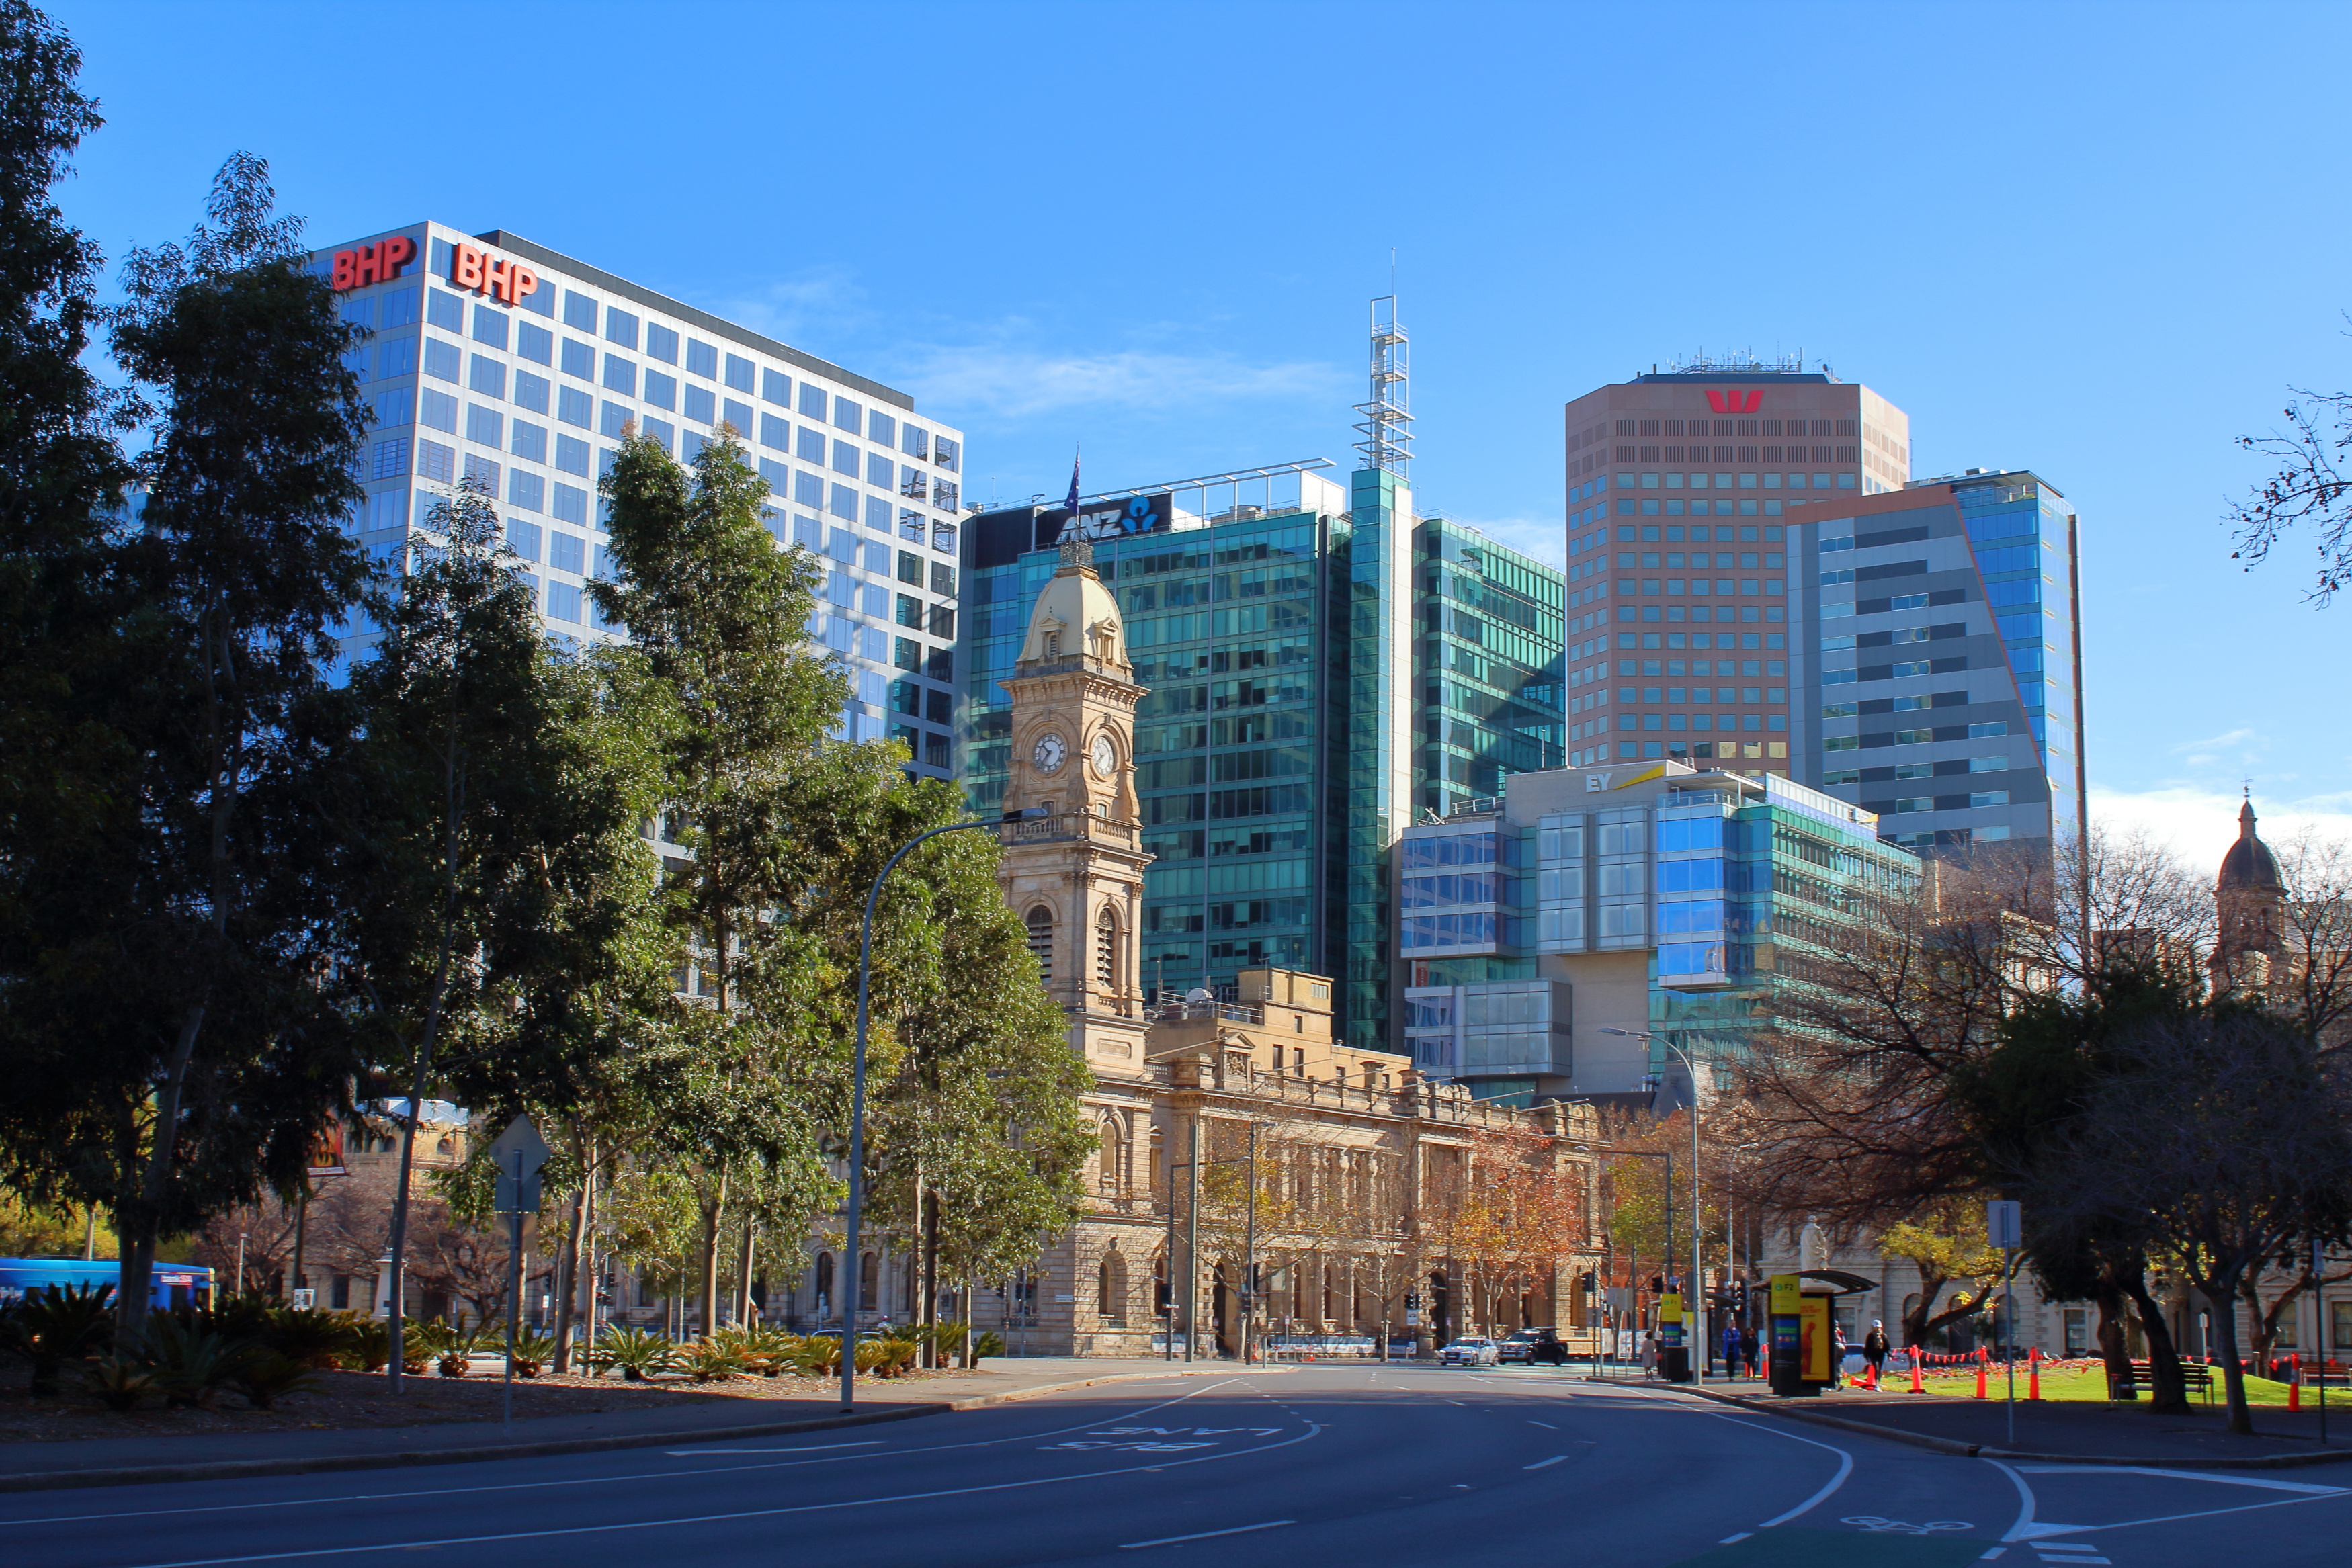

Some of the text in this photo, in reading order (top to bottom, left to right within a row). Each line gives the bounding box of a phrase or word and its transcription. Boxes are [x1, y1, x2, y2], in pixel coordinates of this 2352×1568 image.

[333, 236, 412, 292] BHP
[453, 243, 538, 306] BHP
[1055, 509, 1122, 545] ANZ
[1586, 773, 1612, 793] EY
[1086, 1426, 1284, 1436] LANE
